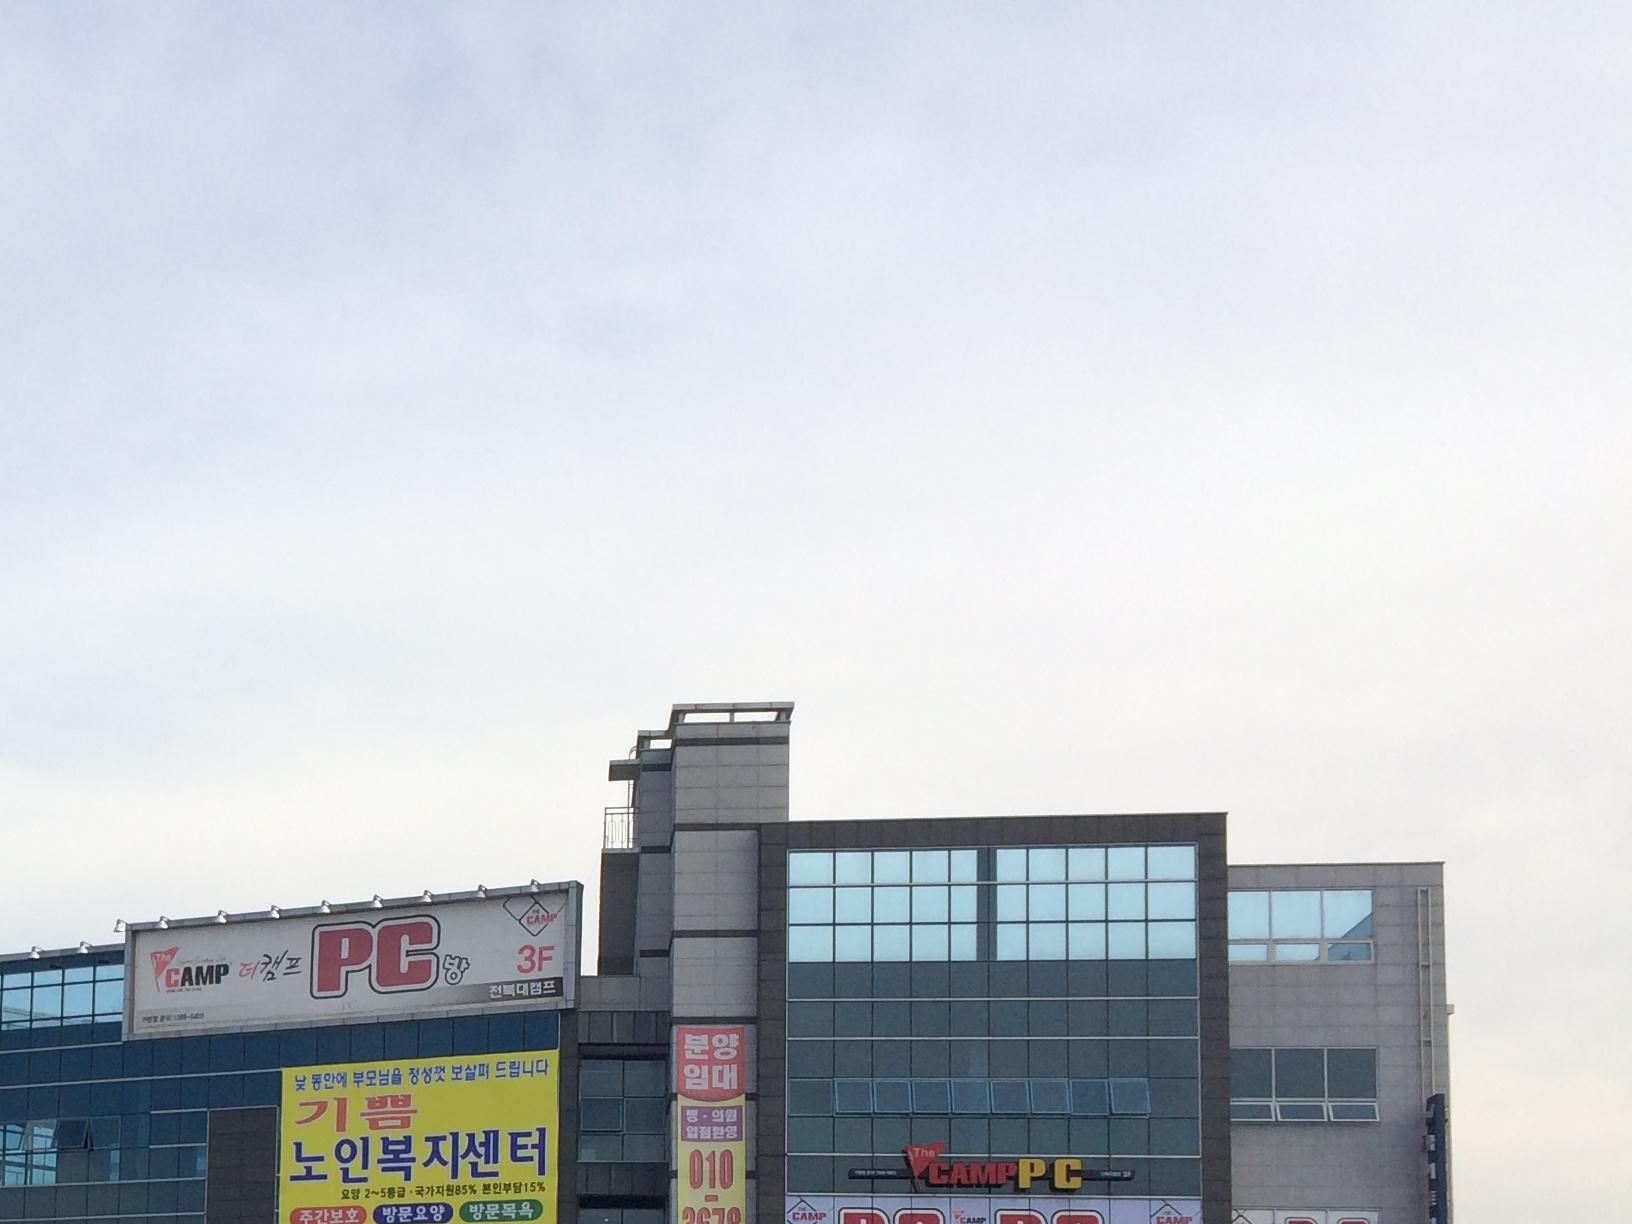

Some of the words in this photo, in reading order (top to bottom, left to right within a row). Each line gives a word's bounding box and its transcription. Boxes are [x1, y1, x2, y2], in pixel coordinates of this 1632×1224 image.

[239, 950, 302, 982] 더캠프
[313, 917, 439, 997] PC
[443, 955, 470, 985] 방
[517, 944, 555, 974] 3F
[165, 963, 230, 988] CAMP
[489, 980, 556, 999] 전북대캠프
[684, 1034, 739, 1060] 분양
[312, 1072, 347, 1091] 동안에
[353, 1067, 402, 1087] 부모님을
[408, 1065, 446, 1085] 정성껏
[451, 1062, 489, 1081] 보살펴
[495, 1058, 549, 1078] 드립니다
[684, 1064, 739, 1090] 임대
[295, 1094, 418, 1133] 기쁨
[289, 1126, 547, 1184] 노인복지센터
[914, 1147, 935, 1158] The
[689, 1149, 734, 1190] 010
[929, 1161, 1018, 1186] CAMP
[1018, 1157, 1083, 1190] PC
[341, 1188, 360, 1200] 요양
[481, 1182, 546, 1195] 본인부담15%
[382, 1205, 446, 1222] 방문요양
[469, 1202, 534, 1220] 방문목욕
[792, 1212, 827, 1222] CAMP
[960, 1217, 987, 1224] CAMP
